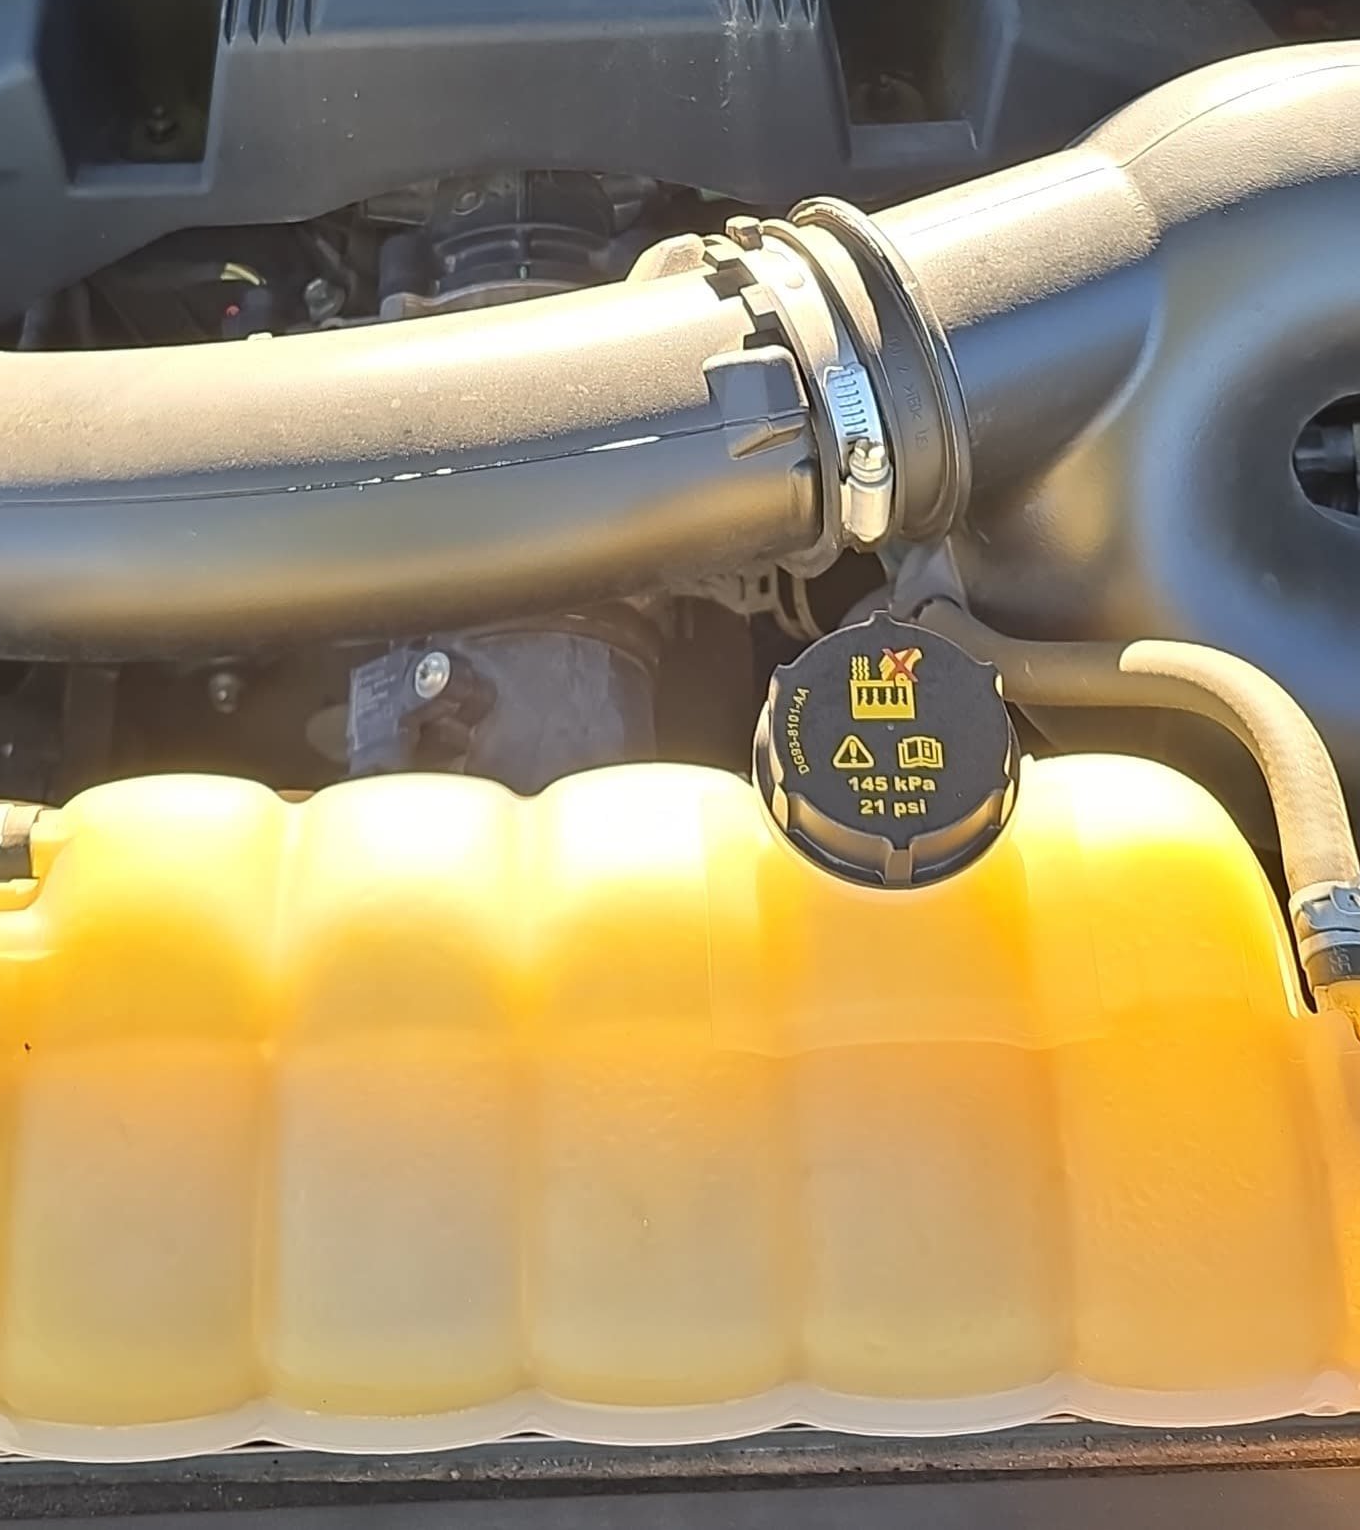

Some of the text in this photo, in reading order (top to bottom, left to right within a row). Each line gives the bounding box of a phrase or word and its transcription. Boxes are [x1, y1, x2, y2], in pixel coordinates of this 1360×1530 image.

[787, 687, 810, 775] DG93-8101-AA
[847, 775, 936, 792] 145 kPa
[859, 798, 927, 818] 21 psi
